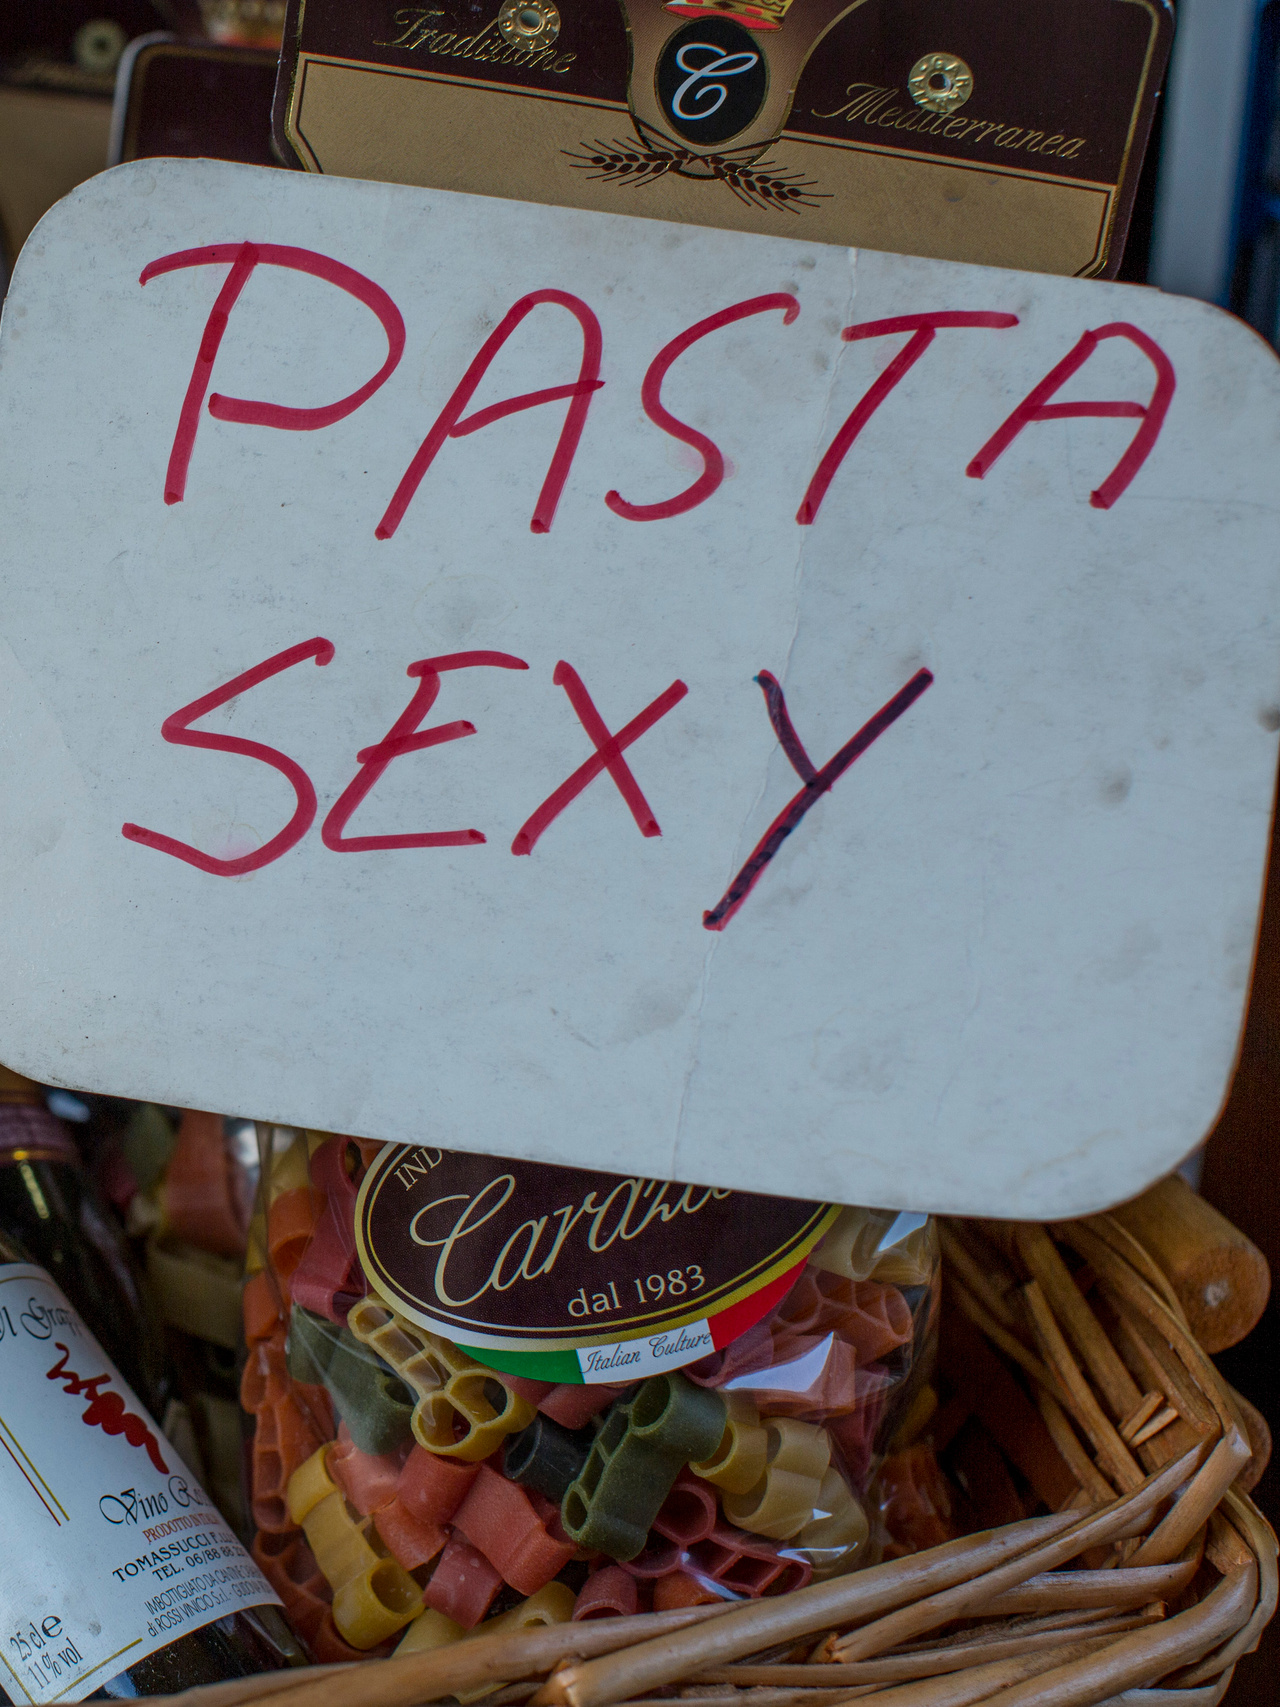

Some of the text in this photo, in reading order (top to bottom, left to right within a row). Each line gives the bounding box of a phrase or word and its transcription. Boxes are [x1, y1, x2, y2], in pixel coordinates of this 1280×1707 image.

[372, 8, 577, 73] Tradizione
[811, 82, 1086, 159] Mediterranea
[136, 240, 1177, 539] PASTA
[122, 636, 934, 933] SEXY
[394, 1147, 456, 1192] IND
[567, 1265, 706, 1318] dal 1983
[578, 1330, 713, 1376] Italian Culture
[99, 1487, 169, 1526] Vino
[142, 1515, 193, 1544] PRODOTTO
[112, 1533, 211, 1583] TOMASSUCCI
[152, 1562, 185, 1582] TEL.
[185, 1548, 221, 1568] 06/88
[144, 1576, 207, 1616] IMBOTTIGLIATO
[203, 1572, 219, 1589] DA
[147, 1621, 159, 1638] di
[155, 1608, 185, 1633] ROSSI
[182, 1596, 215, 1619] VINICIO
[9, 1631, 33, 1661] 25
[29, 1622, 47, 1649] cl
[57, 1636, 83, 1668] vol
